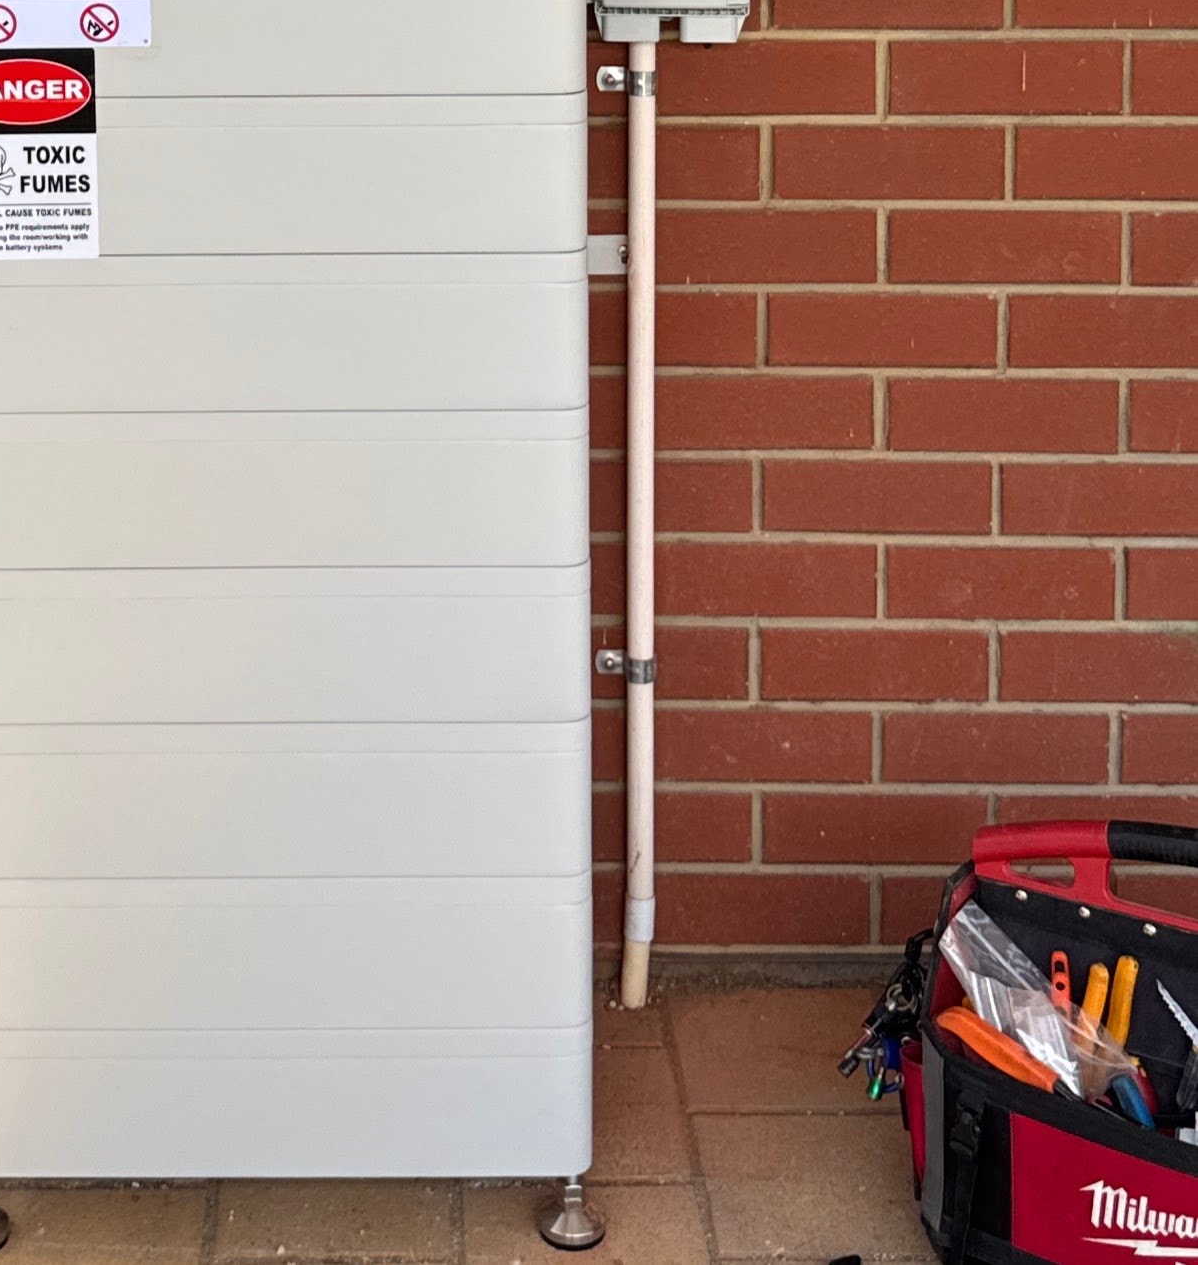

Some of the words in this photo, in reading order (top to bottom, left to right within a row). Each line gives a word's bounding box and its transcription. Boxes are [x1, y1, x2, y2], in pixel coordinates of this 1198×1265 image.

[23, 146, 86, 164] TOXIC
[19, 175, 91, 193] FUMES
[5, 209, 33, 217] CAUSE
[36, 209, 60, 217] TOXIC
[63, 208, 92, 216] FUMES
[21, 223, 68, 232] requirements
[70, 223, 90, 231] apply
[5, 244, 31, 252] battery
[33, 244, 63, 252] systems
[1079, 1179, 1198, 1239] Milwa
